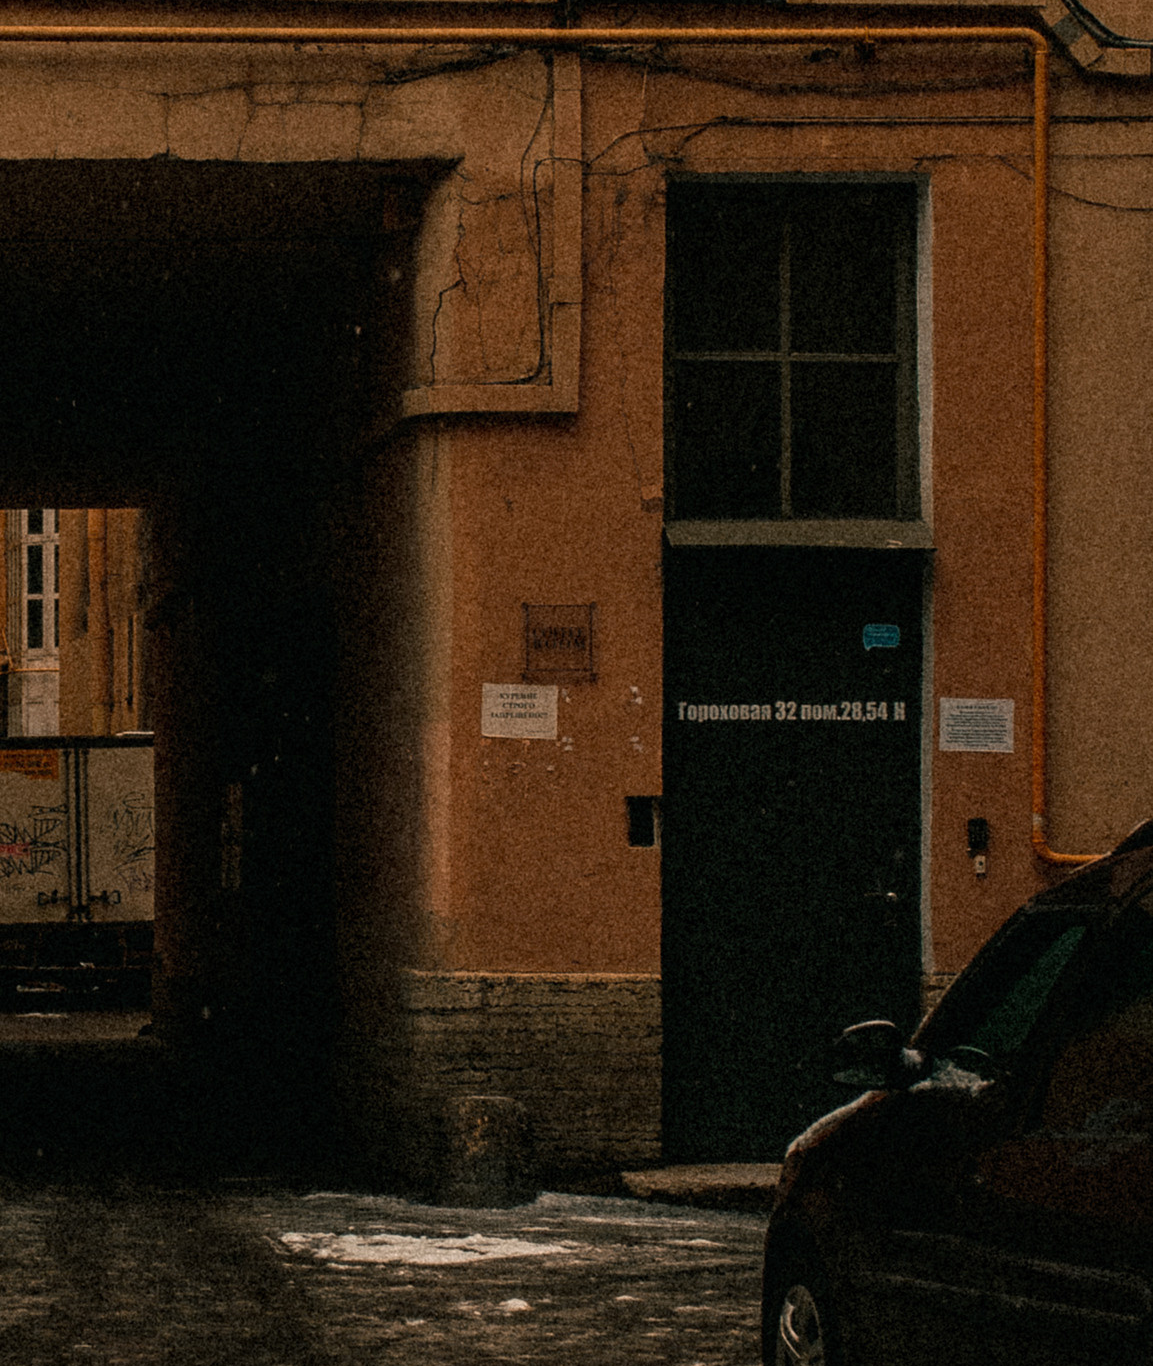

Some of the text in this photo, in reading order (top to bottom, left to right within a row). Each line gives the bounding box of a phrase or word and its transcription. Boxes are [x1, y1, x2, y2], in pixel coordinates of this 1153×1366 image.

[499, 692, 538, 700] КУРЕНИЕ
[678, 701, 906, 723] Гороховая 32 пом.28,54 Н
